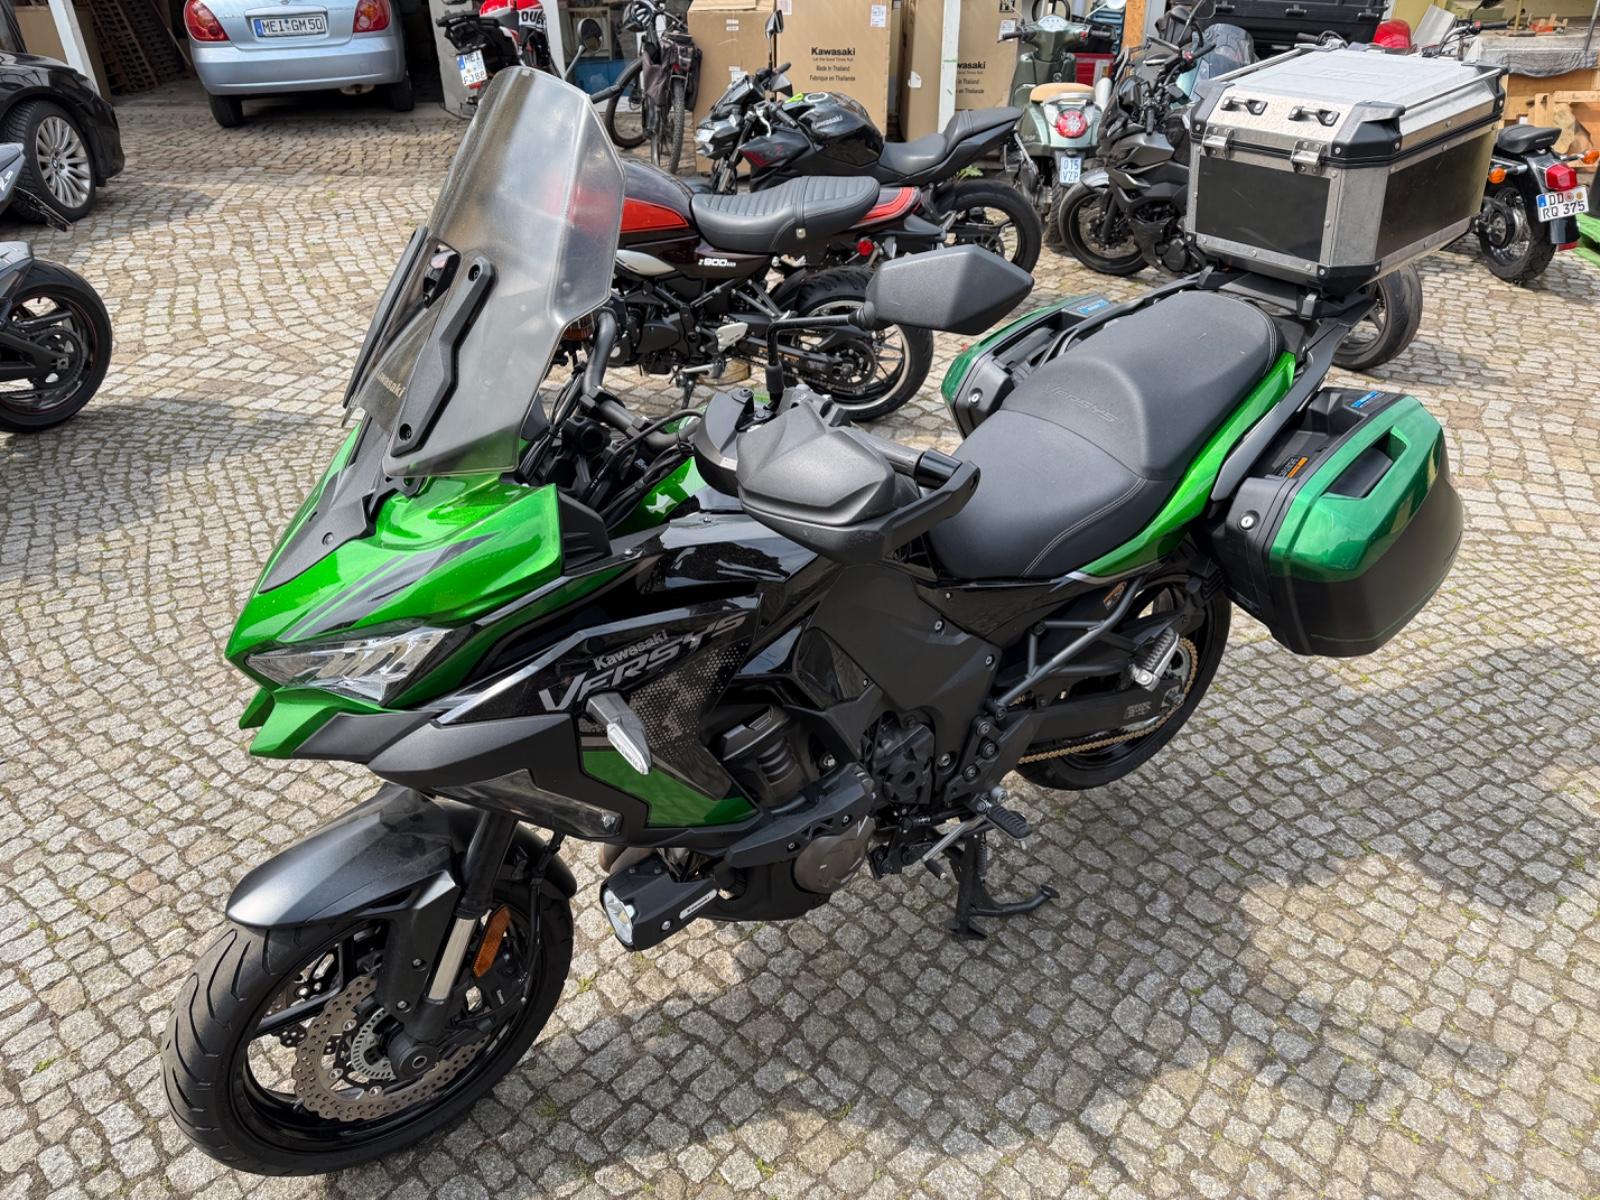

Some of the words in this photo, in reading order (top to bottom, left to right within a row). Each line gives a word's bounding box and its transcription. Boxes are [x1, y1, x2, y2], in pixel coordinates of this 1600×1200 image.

[262, 20, 285, 33] MEI
[811, 47, 856, 56] Kawasaki
[464, 52, 481, 64] MEI
[957, 61, 987, 70] wasaki
[1063, 159, 1080, 170] 015
[1062, 171, 1079, 182] VZP
[1548, 192, 1564, 206] DD
[1542, 205, 1559, 219] RQ
[1563, 201, 1585, 215] 375
[592, 629, 669, 671] Kawasaki
[538, 610, 750, 711] VERSYS
